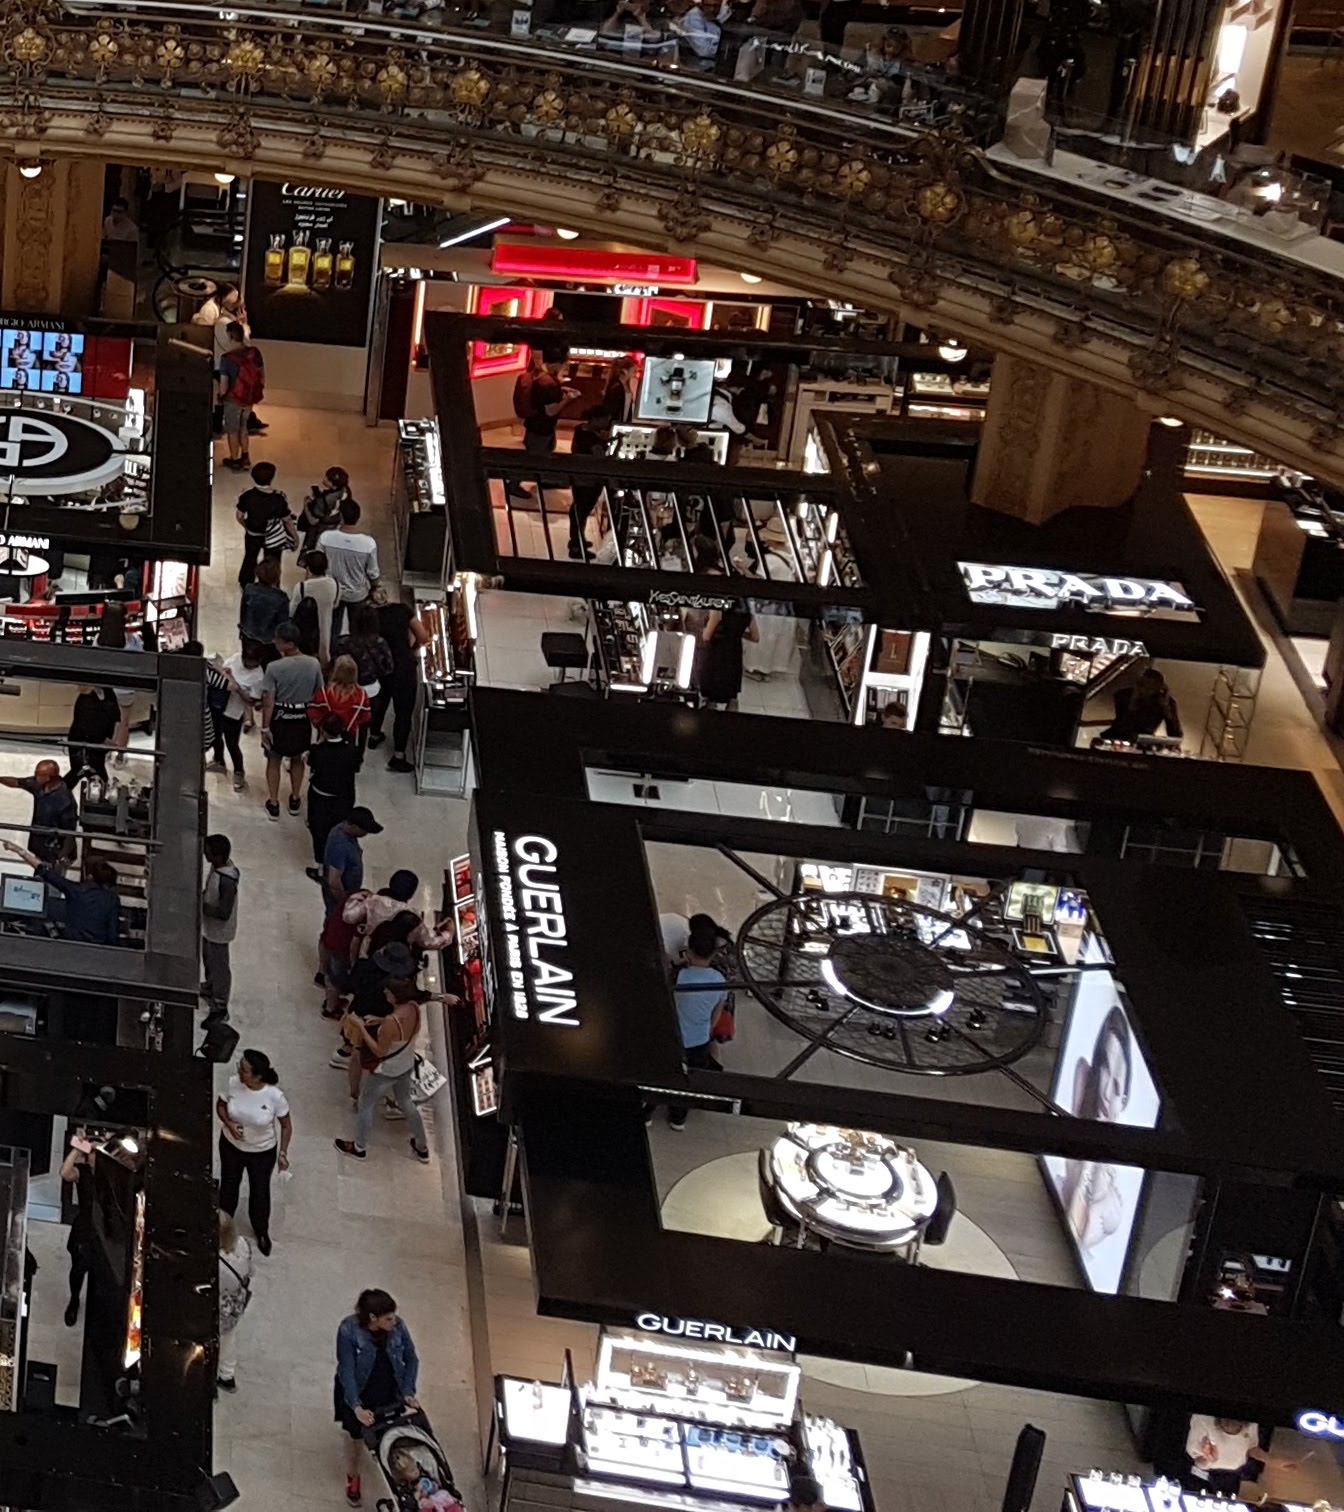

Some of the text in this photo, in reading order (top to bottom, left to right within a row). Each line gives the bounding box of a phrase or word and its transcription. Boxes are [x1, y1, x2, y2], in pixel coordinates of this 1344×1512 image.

[26, 318, 65, 330] ARMANI
[7, 535, 50, 550] ARMANI
[965, 564, 1195, 609] PRADA
[1051, 633, 1150, 657] PRADA
[493, 830, 510, 873] MAISON
[515, 835, 581, 1026] GUERLAIN
[507, 934, 523, 969] PARIS
[510, 970, 525, 988] EN
[636, 1312, 797, 1353] GUERLAIN
